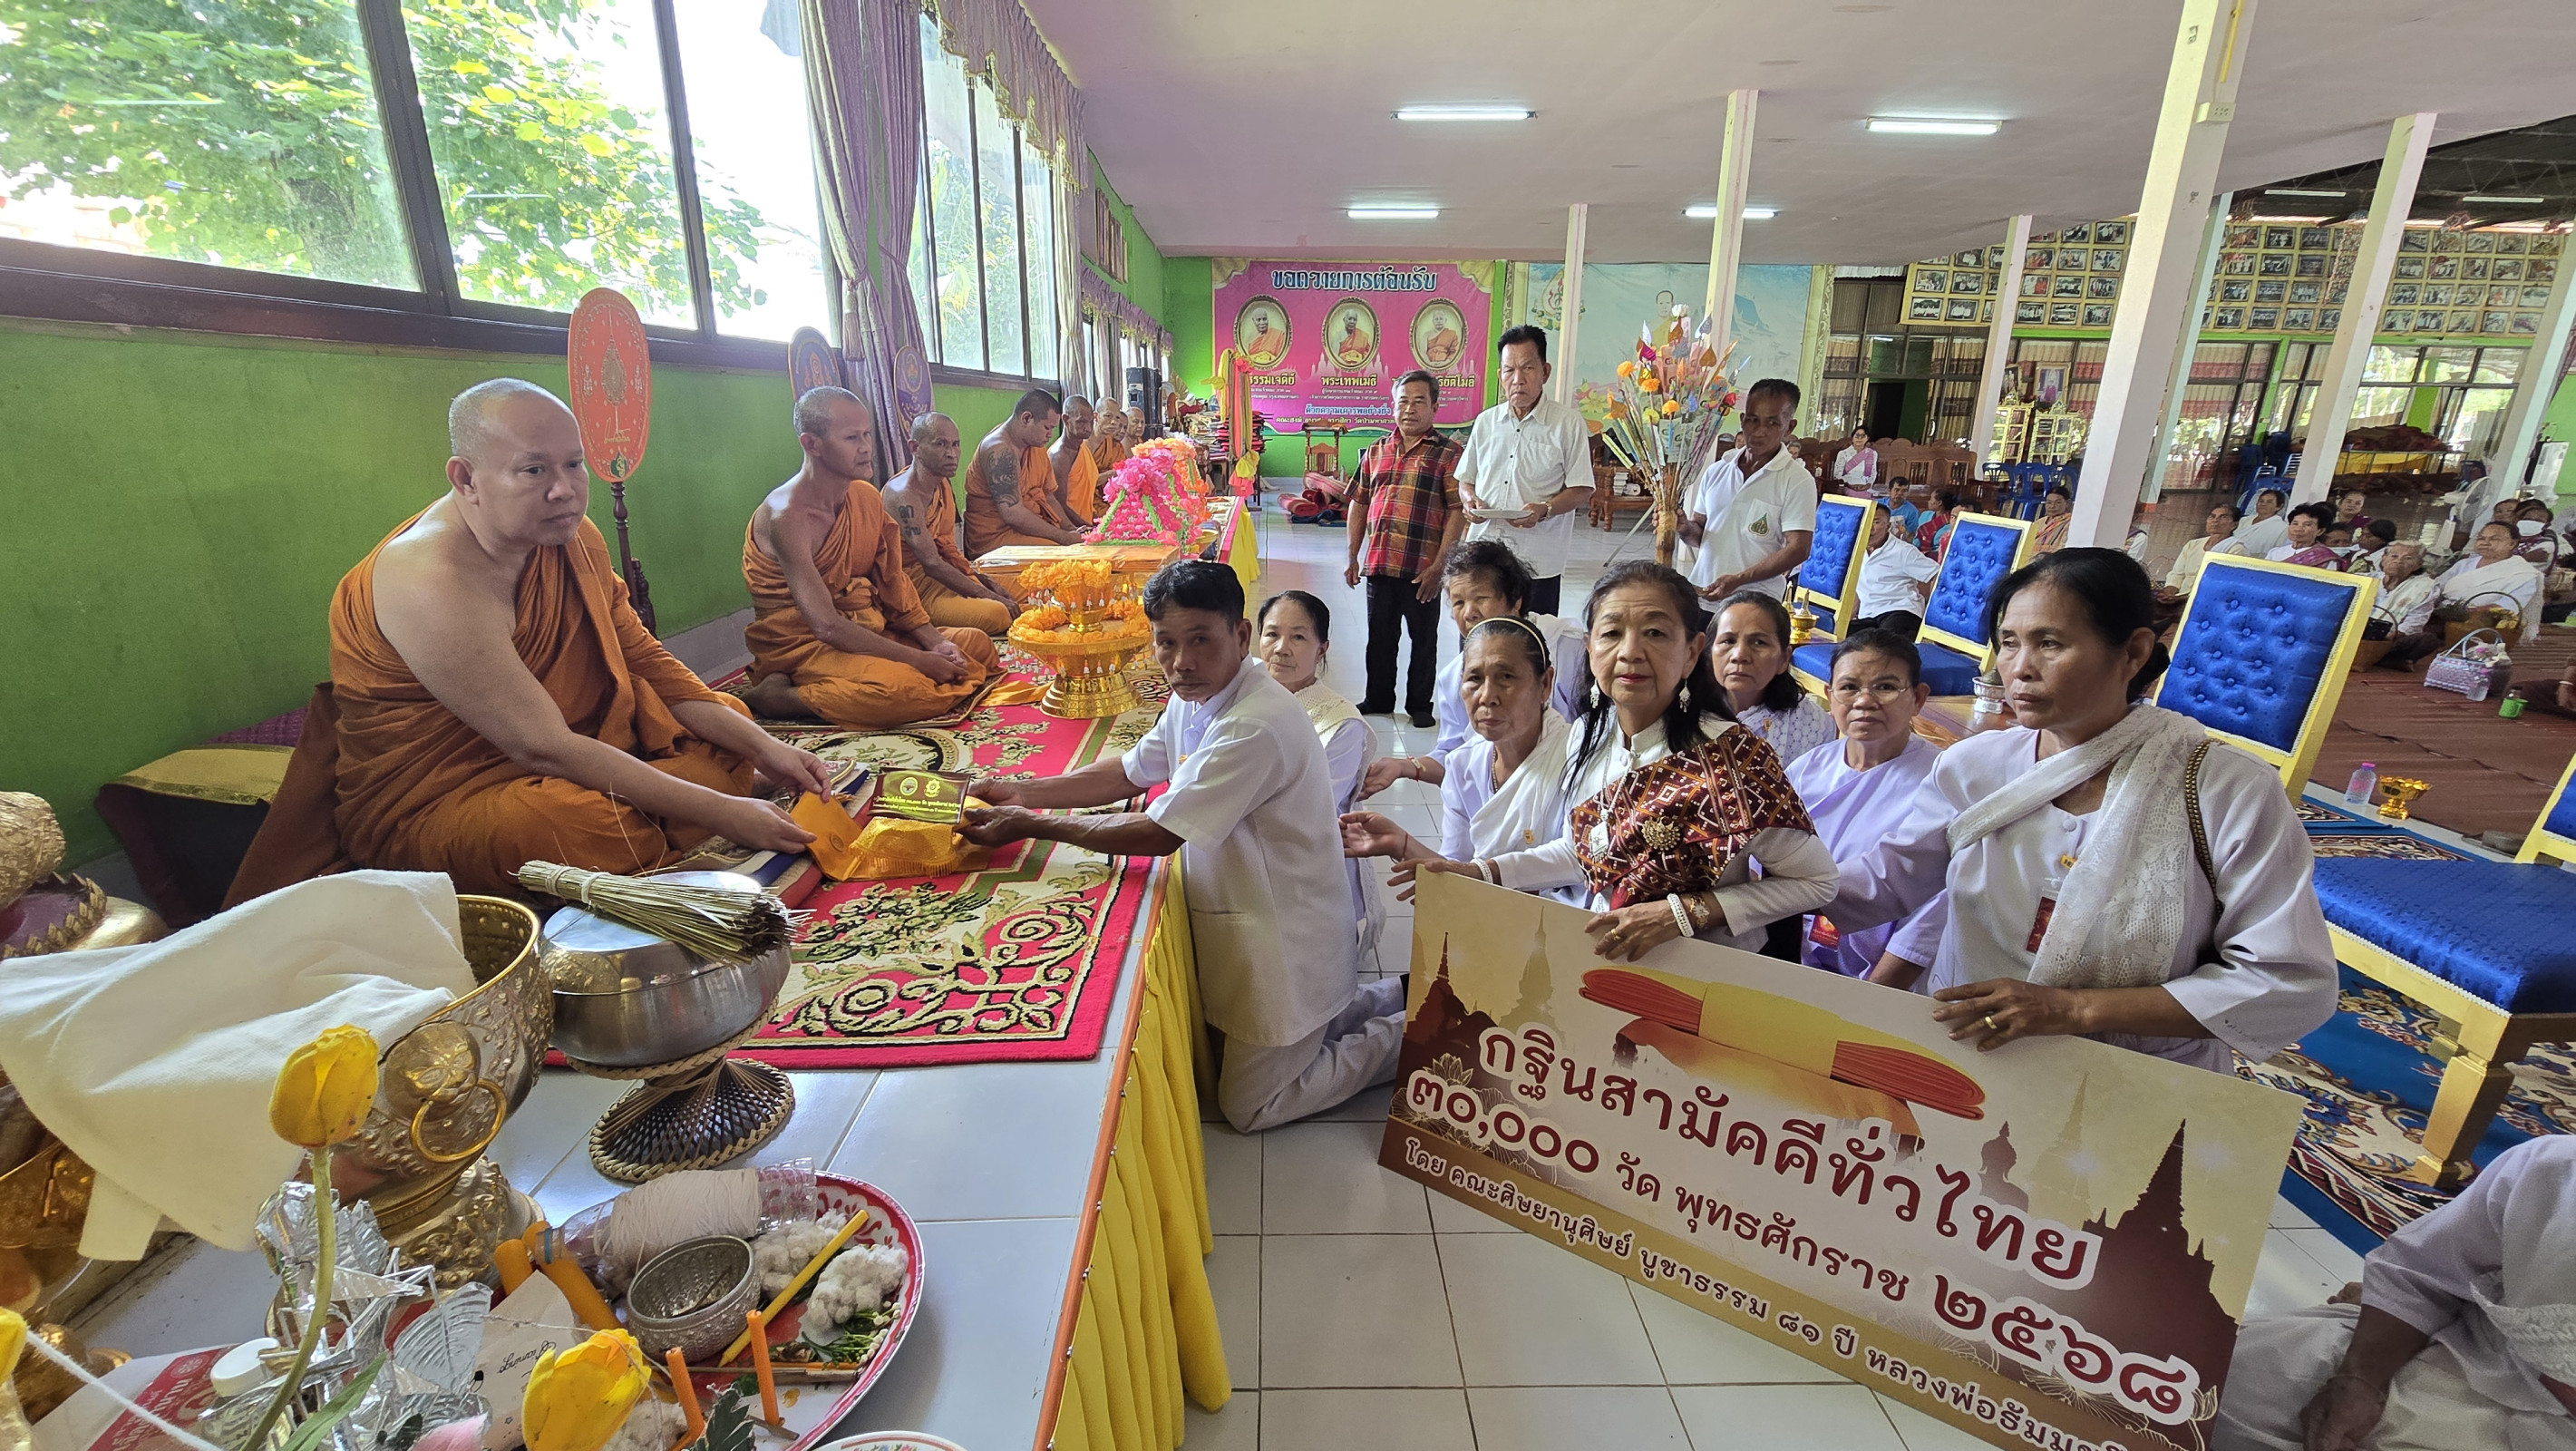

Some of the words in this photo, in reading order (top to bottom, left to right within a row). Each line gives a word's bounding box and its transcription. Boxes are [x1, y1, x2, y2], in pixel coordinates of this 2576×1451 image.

[1271, 266, 1438, 291] ขอถวายการต้อนรับ
[1306, 404, 1392, 415] ด้วยความเคารพอย่างยิ่ง
[1321, 373, 1377, 386] พระเทพเมธี
[1485, 1027, 2088, 1280] กฐินสามัคคีทั่วไทย
[1406, 1141, 1444, 1173] โดย
[1451, 1168, 1632, 1258] คณะศิษยานุศิษย์
[1640, 1250, 1767, 1319] บูชาธรรม
[1778, 1313, 1820, 1342] ๘๑
[1835, 1326, 1855, 1356] ปี
[1868, 1349, 2129, 1451] หลวงพ่อธัมม
[1412, 1076, 1599, 1173] ๓๐,๐๐๐
[1616, 1152, 1661, 1202] วัด
[1676, 1186, 1910, 1301] พุทธศักราช
[1935, 1274, 2186, 1414] ๒๕๖๘
